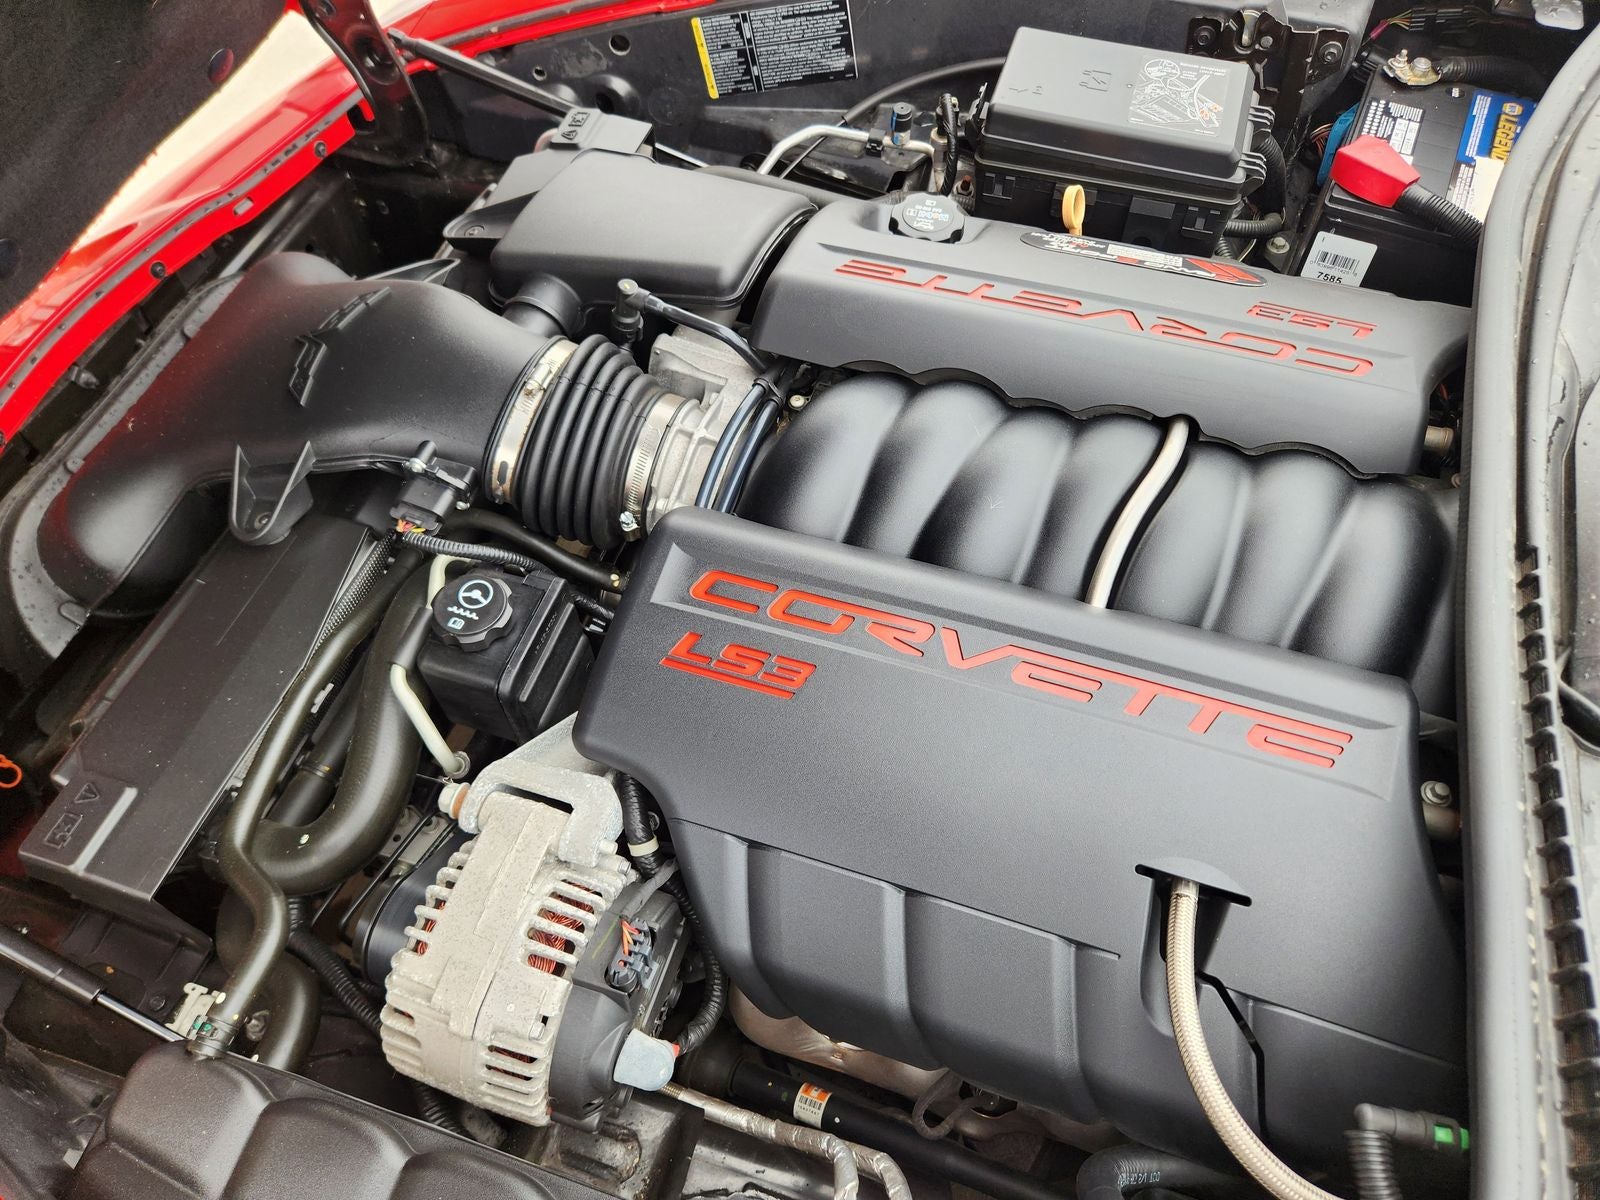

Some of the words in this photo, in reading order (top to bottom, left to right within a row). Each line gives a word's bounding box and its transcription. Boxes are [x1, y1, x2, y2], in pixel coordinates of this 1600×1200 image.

[1316, 271, 1343, 284] 7585
[835, 259, 1375, 376] CORVETTE
[1247, 302, 1377, 338] LS3
[659, 631, 817, 700] LS3
[688, 568, 1353, 769] CORVETTE
